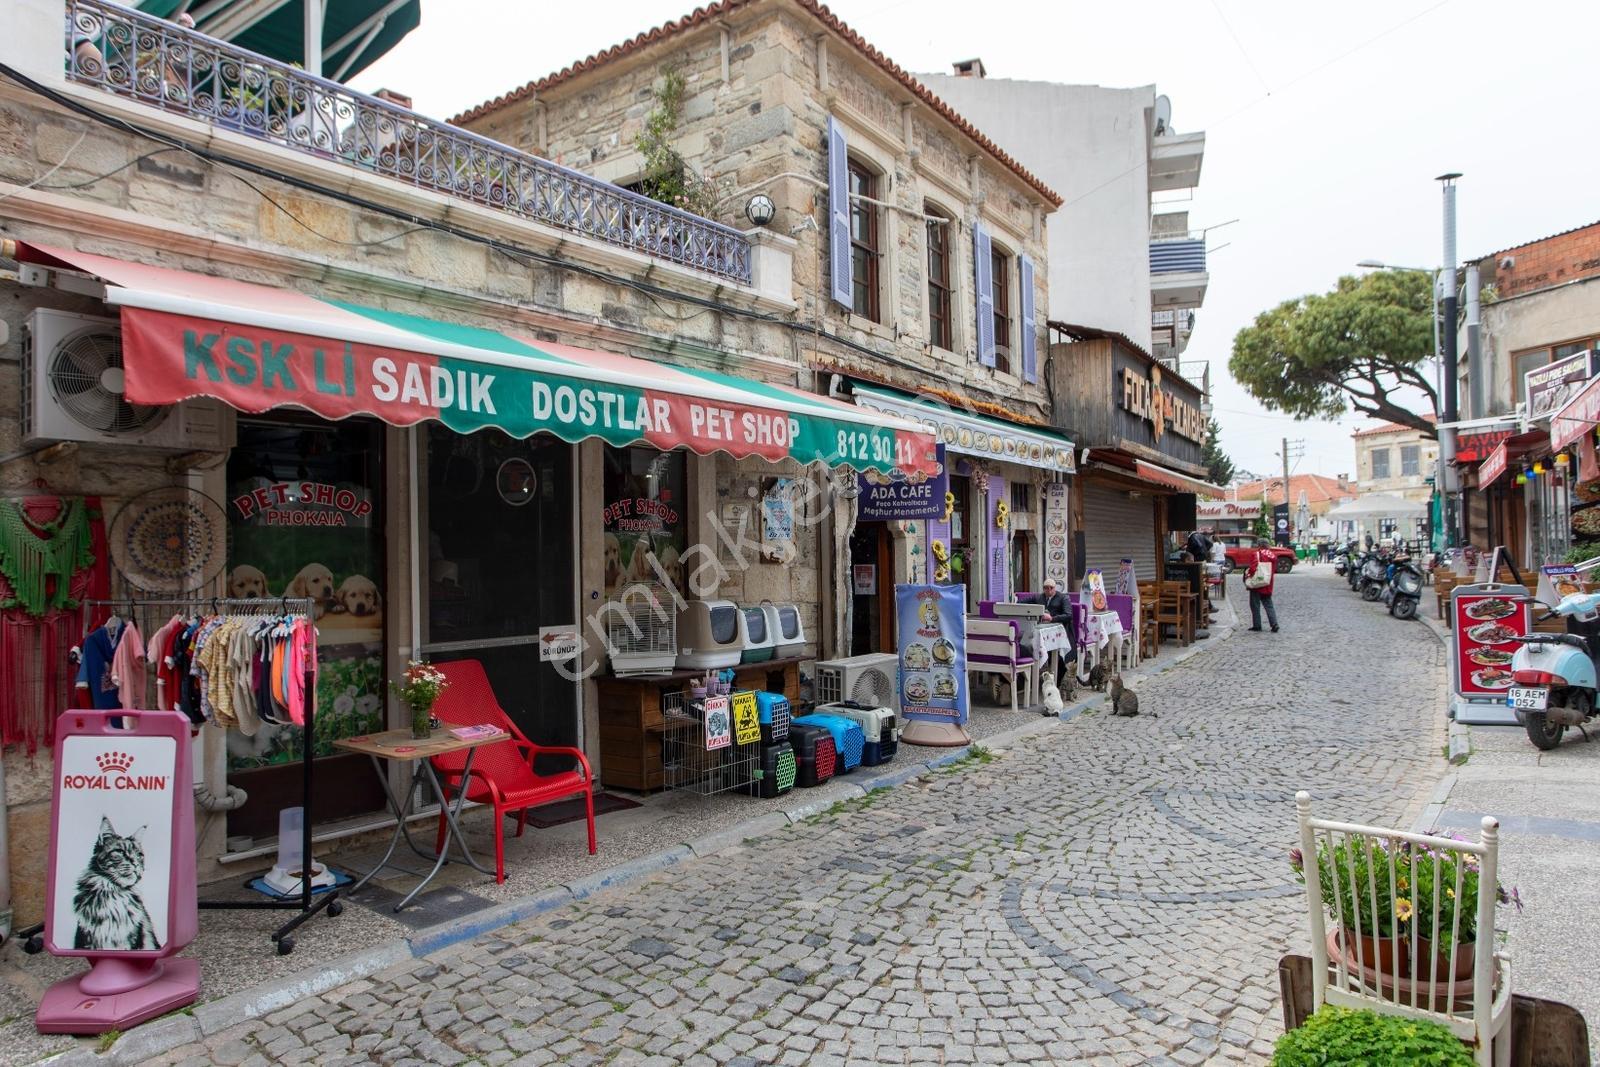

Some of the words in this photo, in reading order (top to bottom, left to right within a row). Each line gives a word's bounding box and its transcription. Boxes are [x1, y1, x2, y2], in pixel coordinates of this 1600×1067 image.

[182, 329, 299, 392] KSK
[371, 357, 498, 415] SADIK
[532, 382, 672, 433] DOSTLAR
[690, 405, 734, 441] PET
[743, 412, 800, 447] SHOP
[837, 430, 869, 461] 812
[871, 436, 891, 463] 30
[895, 439, 913, 465] 11
[870, 487, 897, 500] ADA
[900, 485, 932, 499] CAFE
[233, 482, 289, 519] PET
[299, 482, 373, 518] SHOP
[267, 509, 347, 526] PHOKAIA
[604, 498, 632, 525] PET
[636, 497, 679, 525] SHOP
[864, 506, 892, 517] Meşhur
[893, 504, 940, 516] Menemenci
[1511, 689, 1520, 698] 16
[1524, 690, 1546, 700] AEM
[1515, 699, 1536, 708] 052
[64, 775, 111, 789] ROYAL
[115, 776, 166, 790] CANIN
